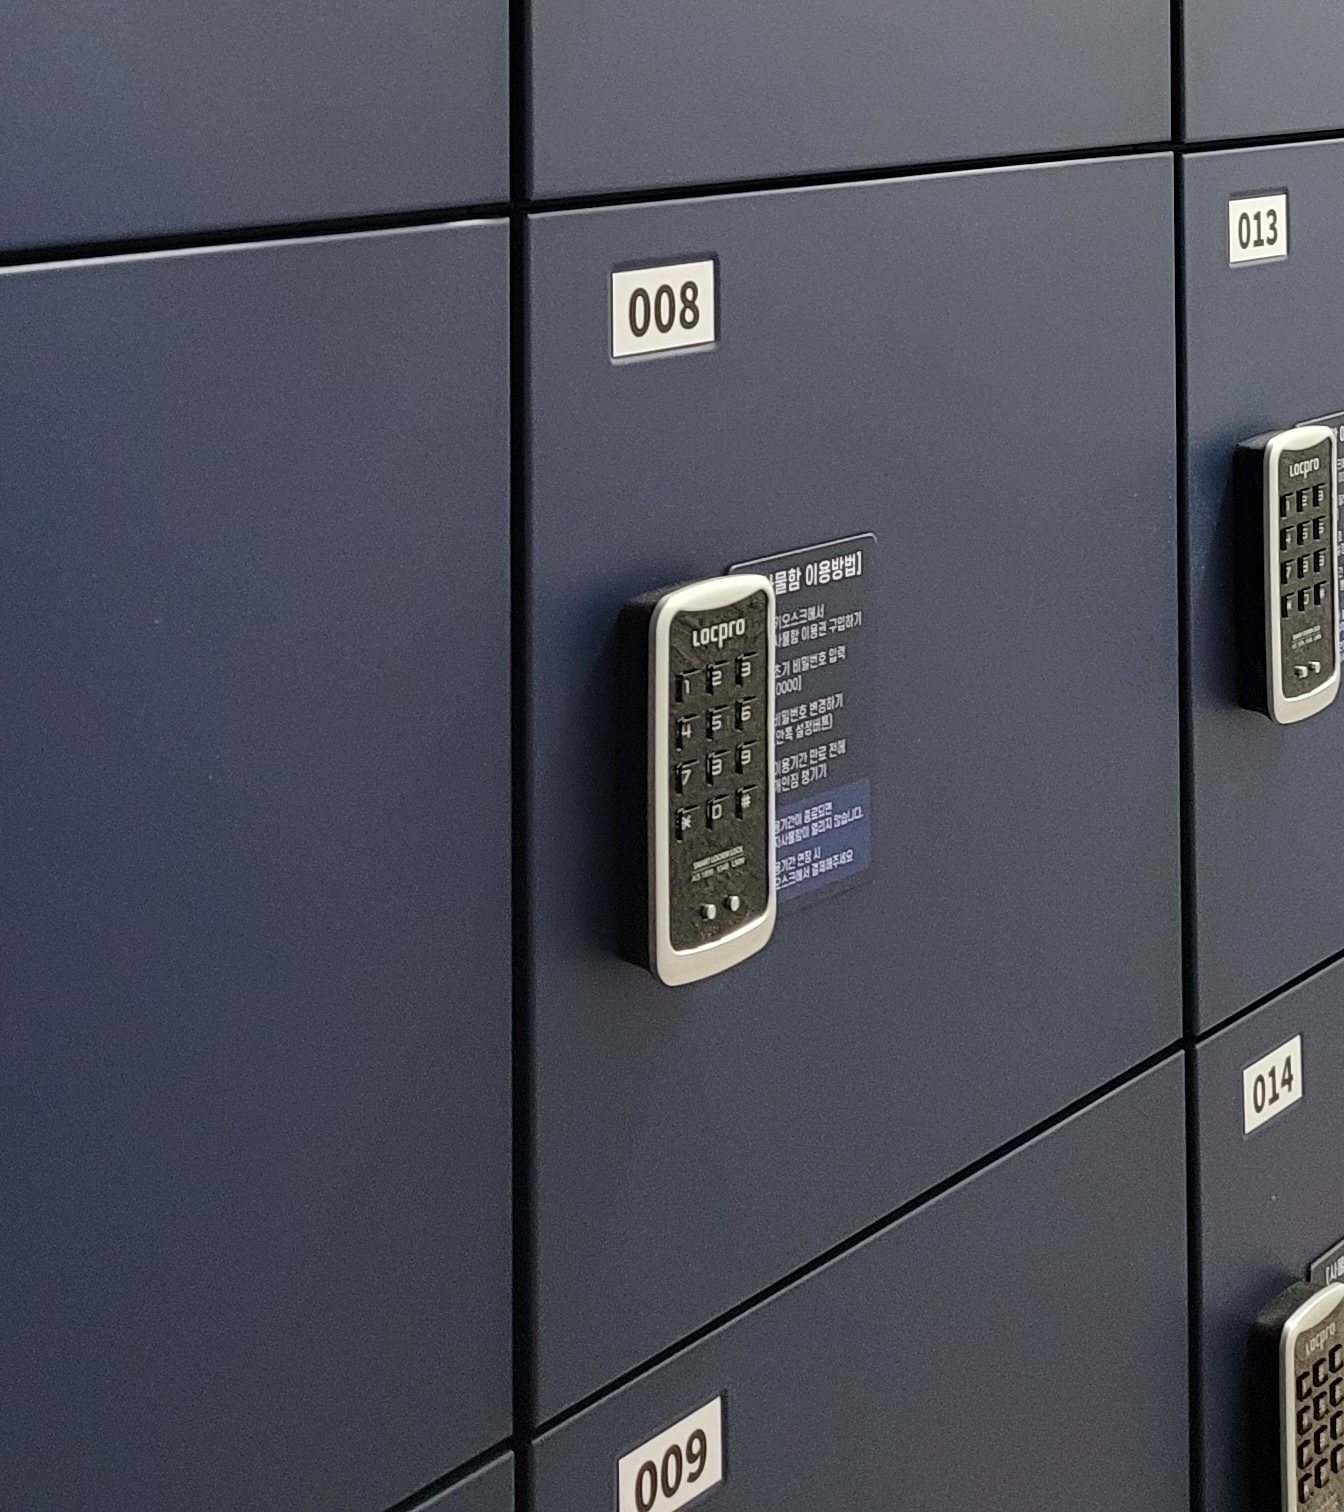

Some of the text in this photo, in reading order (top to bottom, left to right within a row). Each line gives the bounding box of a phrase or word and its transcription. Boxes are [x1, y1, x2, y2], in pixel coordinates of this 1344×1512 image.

[1238, 208, 1277, 250] 013
[629, 281, 699, 337] 008
[806, 551, 862, 586] 이용방법]
[1253, 1055, 1293, 1114] 014
[635, 1428, 707, 1512] 009
